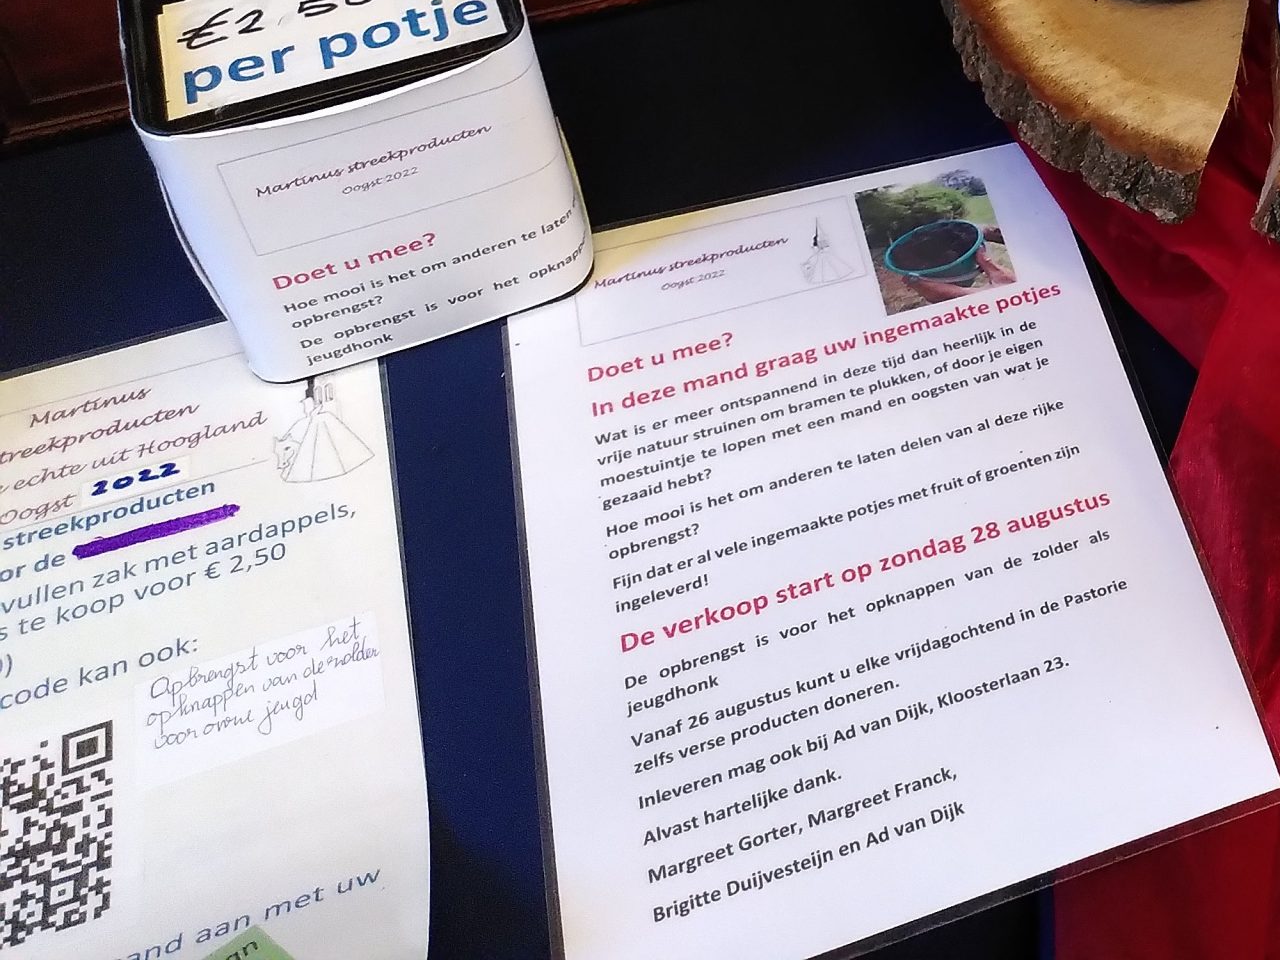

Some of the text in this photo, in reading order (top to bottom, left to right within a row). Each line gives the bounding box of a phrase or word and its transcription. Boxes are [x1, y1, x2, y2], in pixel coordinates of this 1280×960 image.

[183, 45, 295, 104] per
[256, 126, 492, 197] Martinus streekproducten
[343, 167, 418, 194] Oogst 2022
[272, 233, 435, 290] Doet u mee?
[283, 210, 571, 313] Hoe mooi is het om anderen te laten
[595, 238, 788, 289] Martinus streekproducten
[661, 270, 725, 290] Oogst 2022
[292, 296, 382, 328] opbrengst?
[300, 338, 323, 348] De
[334, 310, 416, 339] opbrengst
[425, 303, 438, 312] is
[448, 288, 483, 304] voor
[493, 277, 520, 291] het
[306, 334, 393, 366] jeugdhonk
[588, 332, 733, 382] Doet u mee?
[592, 285, 1061, 417] In deze mand graag uw ingemaakte potjes
[595, 321, 1036, 445] Wat is er meer ontspannend in deze tijd dan heerlijk in de
[0, 405, 199, 465] treekproducten
[29, 386, 151, 428] Martinus
[13, 411, 268, 490] echte uit Hoogland
[0, 462, 181, 525] Oogst 2022
[3, 482, 214, 550] streekproducten
[34, 554, 65, 572] de
[92, 562, 136, 588] zak
[146, 545, 197, 573] met
[206, 503, 356, 555] aardappels,
[621, 494, 1110, 653] De verkoop start op zondag 28 augustus
[18, 543, 285, 635] te koop voor € 2,50
[80, 660, 127, 686] kan
[138, 638, 197, 667] ook:
[150, 616, 361, 707] Opbrengst voor het
[263, 672, 298, 692] van
[303, 658, 325, 679] de
[631, 580, 1127, 747] Vanaf 26 augustus kunt u elke vrijdagochtend in de Pastorie
[155, 729, 198, 750] voor
[258, 680, 318, 735] jeugd
[639, 657, 1069, 809] Inleveren mag ook bij Ad van Dijk, Kloosterlaan 23.
[648, 767, 957, 884] Margreet Gorter, Margreet Franck,
[653, 802, 965, 922] Brigitte Duijvesteijn en Ad van Dijk
[195, 868, 381, 944] aan met uw
